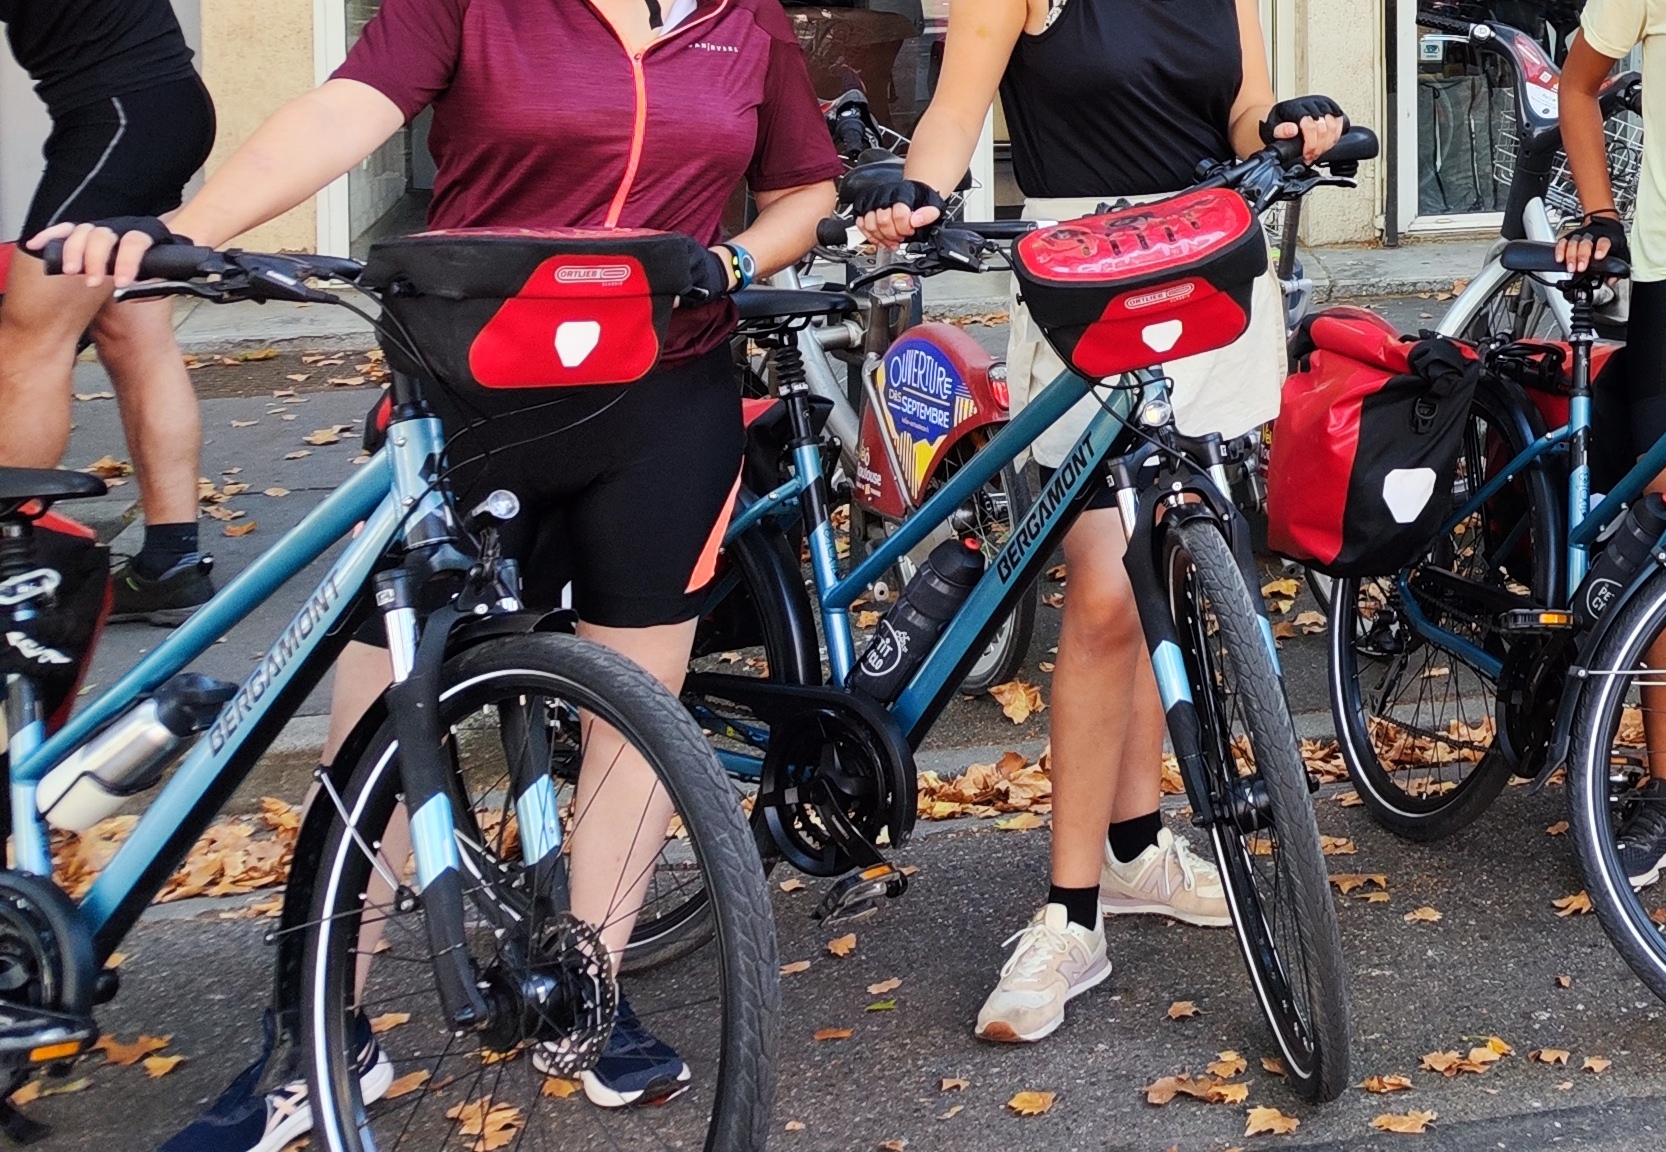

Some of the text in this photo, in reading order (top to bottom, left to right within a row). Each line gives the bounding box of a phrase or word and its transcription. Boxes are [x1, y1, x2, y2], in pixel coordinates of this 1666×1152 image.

[561, 270, 597, 278] ORTLIEB
[1128, 291, 1164, 305] ORTLIEB
[890, 350, 953, 399] OUVERTURE
[901, 396, 949, 428] SEPTEMBRE
[996, 431, 1096, 584] BERGAMONT
[208, 569, 339, 758] BERGAMONT
